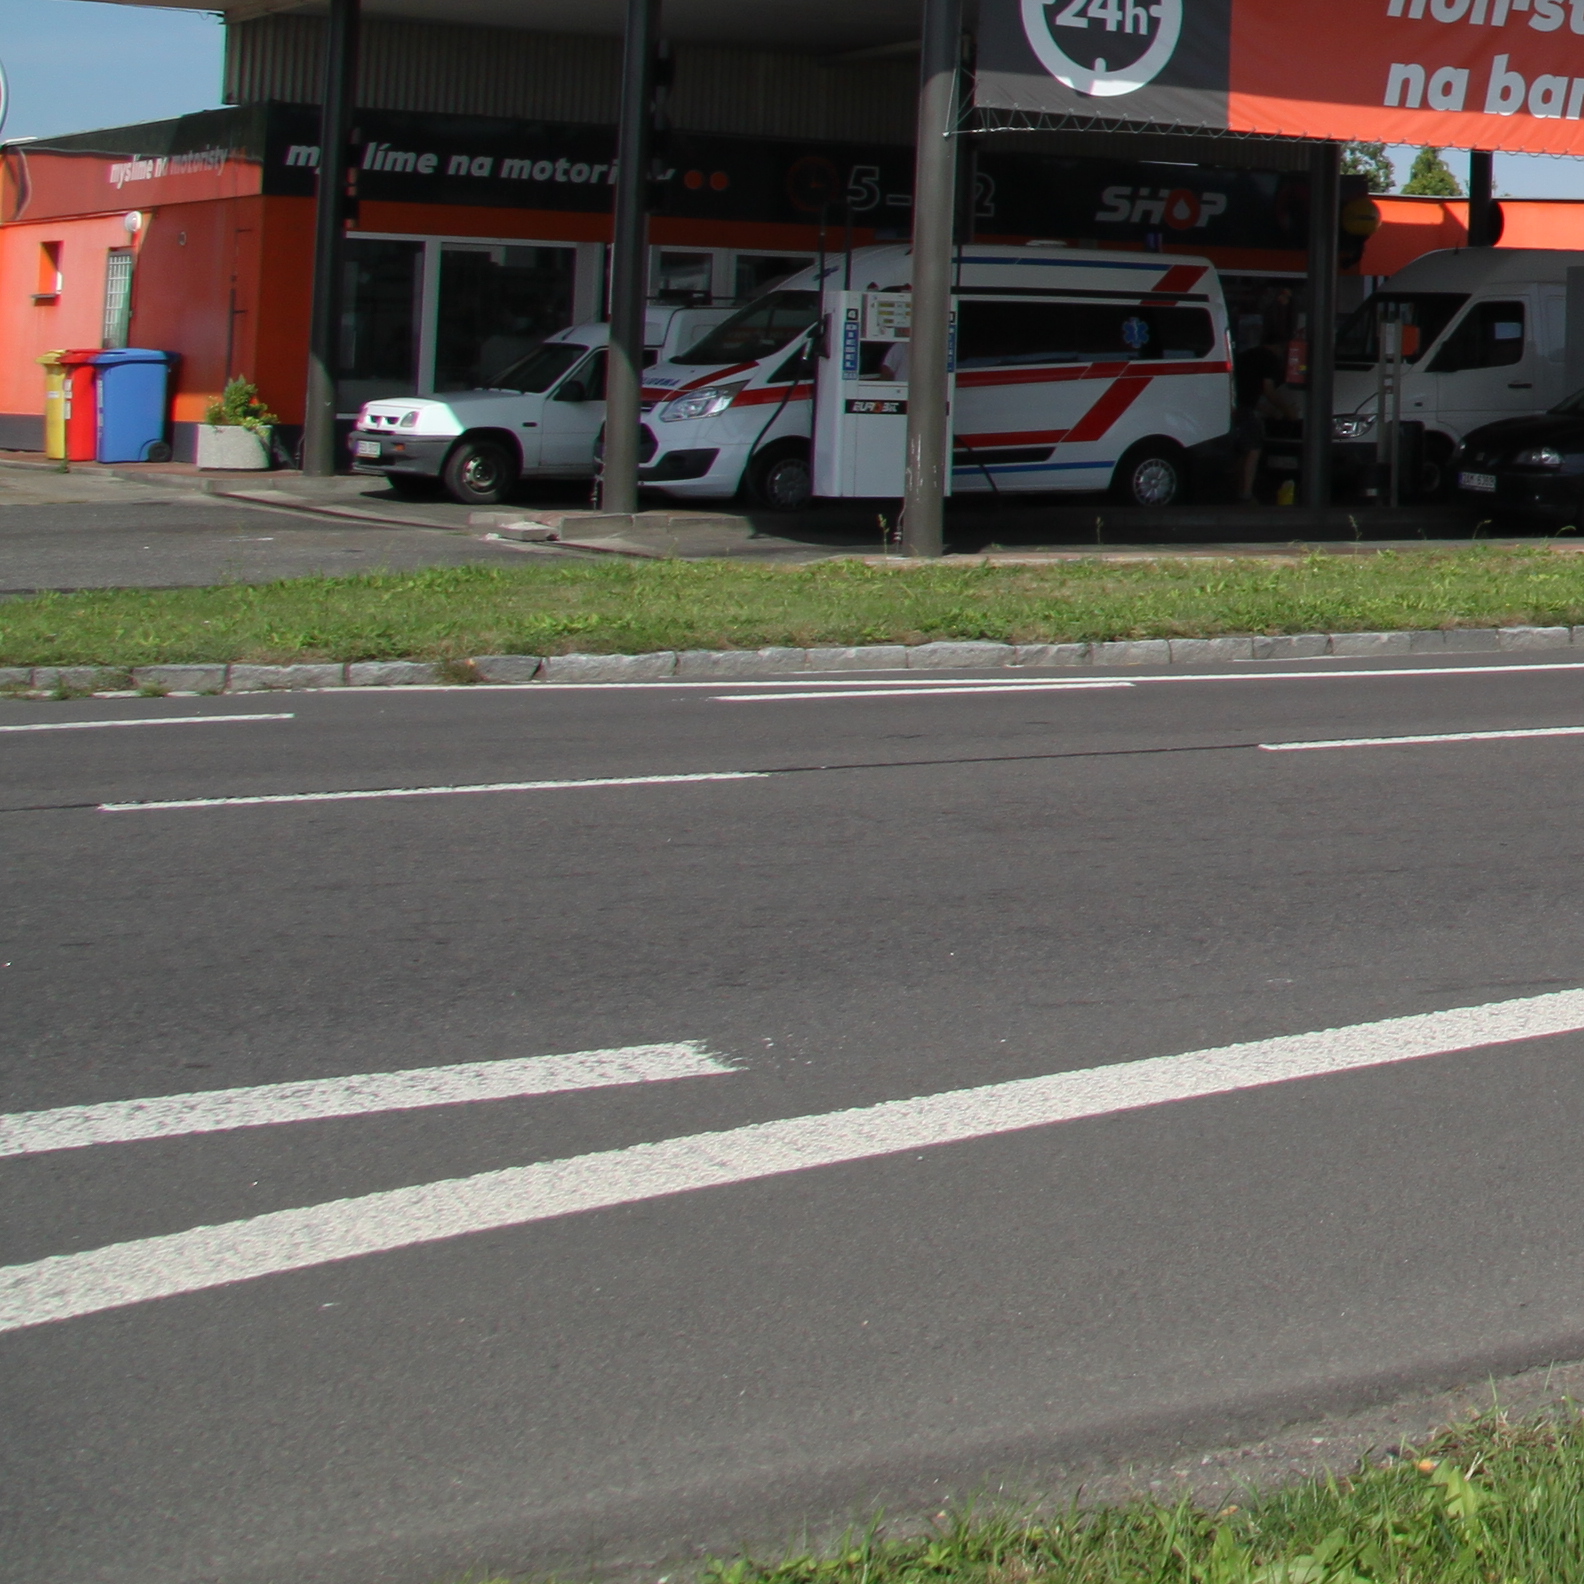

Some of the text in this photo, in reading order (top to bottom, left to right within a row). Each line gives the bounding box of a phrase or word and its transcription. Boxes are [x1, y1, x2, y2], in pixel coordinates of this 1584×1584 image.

[1383, 62, 1470, 112] na
[110, 154, 154, 189] myslíme
[170, 144, 228, 177] motoristy
[285, 142, 438, 175] mlíme
[447, 155, 494, 177] na
[1095, 185, 1227, 229] SHOP
